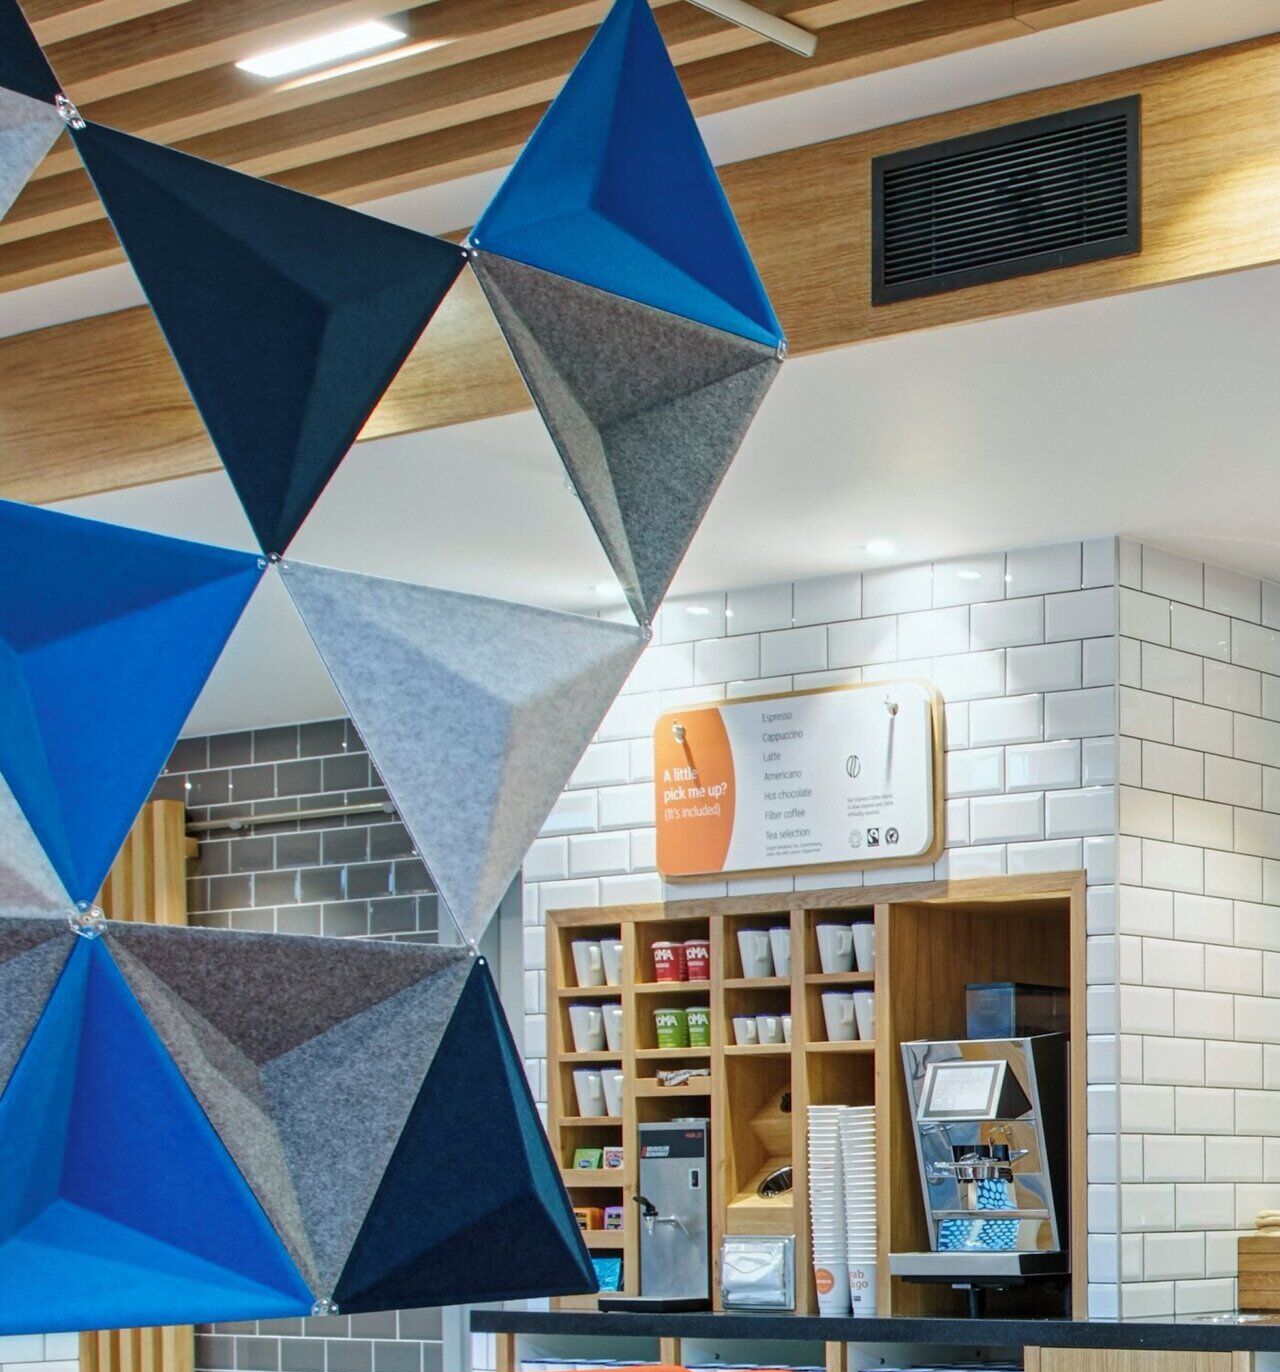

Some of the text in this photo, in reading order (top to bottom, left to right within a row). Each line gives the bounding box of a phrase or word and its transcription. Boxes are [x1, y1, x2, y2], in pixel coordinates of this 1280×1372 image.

[762, 711, 793, 723] Espresso
[762, 730, 804, 743] Cappuccino
[763, 752, 781, 762] Latte
[663, 767, 698, 783] A little
[763, 770, 802, 781] Americano
[663, 782, 728, 804] pick me up?
[764, 788, 813, 801] Hot chocolate
[682, 803, 721, 819] included)
[764, 808, 806, 820] Filter coffee
[766, 828, 811, 840] Tea selection
